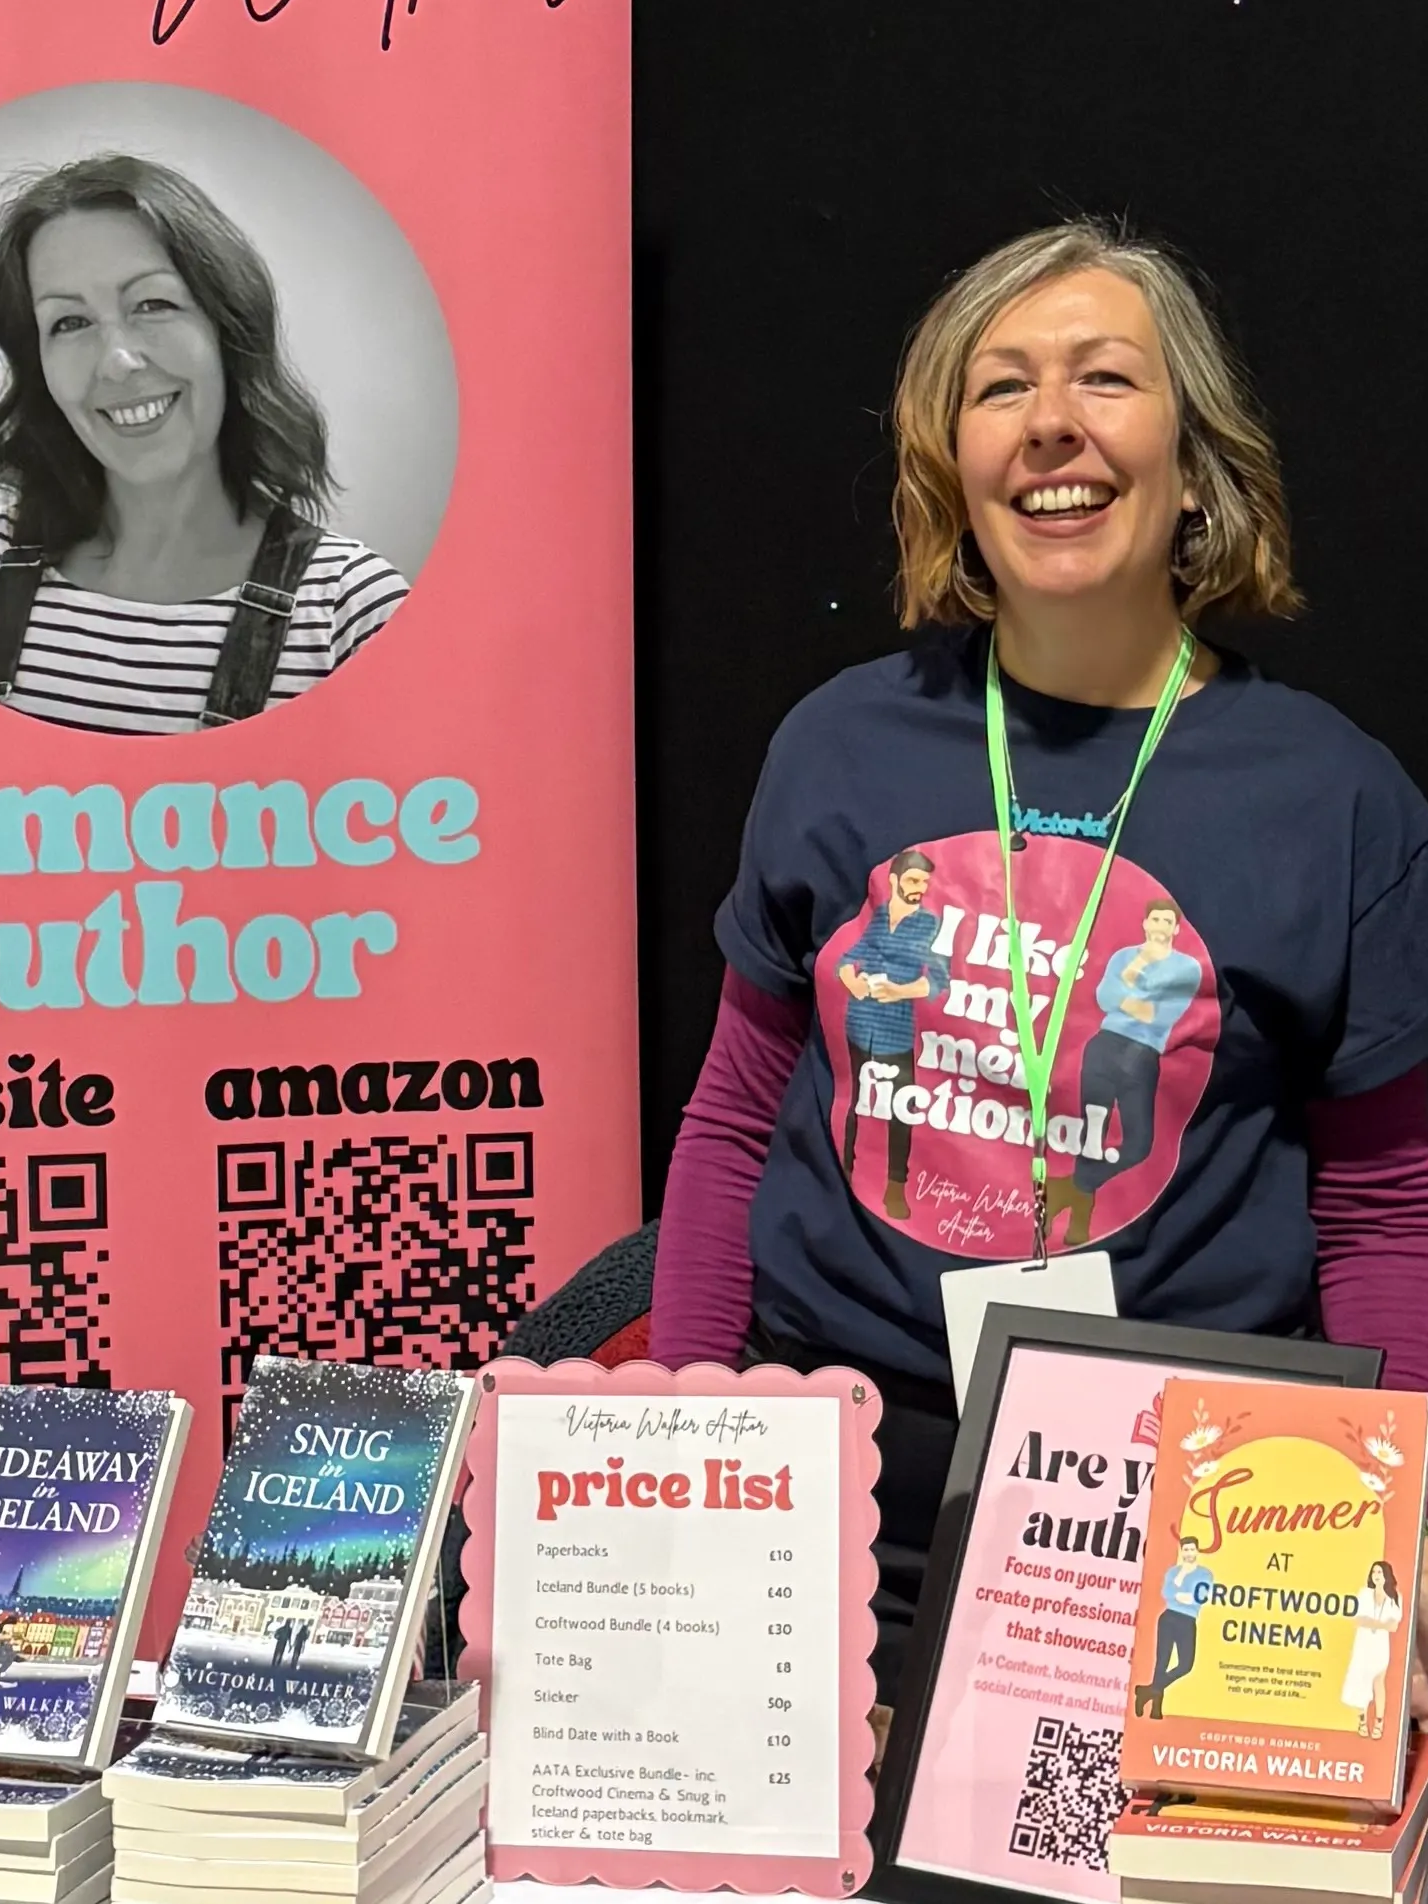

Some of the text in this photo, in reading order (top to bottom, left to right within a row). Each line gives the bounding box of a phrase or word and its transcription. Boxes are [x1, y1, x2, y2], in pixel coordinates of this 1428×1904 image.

[931, 905, 1089, 980] I like
[943, 980, 1050, 1045] my
[205, 1056, 543, 1123] amazon
[855, 1060, 1120, 1163] fictional.
[566, 1405, 768, 1443] Victoria Walker Author
[290, 1423, 392, 1464] SNUG
[319, 1461, 344, 1478] in
[1007, 1431, 1108, 1489] Are
[33, 1483, 58, 1498] in
[244, 1471, 405, 1516] ICELAND
[537, 1456, 794, 1520] price list
[1170, 1467, 1383, 1555] Summer
[537, 1544, 793, 1561] Paperbacks £10
[1266, 1552, 1293, 1572] AT
[1005, 1556, 1052, 1580] Focus
[1054, 1567, 1075, 1583] on
[1076, 1571, 1117, 1590] your
[537, 1581, 792, 1598] Iceland Bundle (5 books) £40
[975, 1587, 1031, 1608] create
[1193, 1581, 1360, 1619] CROFTWOOD
[535, 1617, 792, 1635] Croftwood Bundle (4 books) £30
[1006, 1621, 1127, 1658] that showcase
[1222, 1619, 1323, 1651] CINEMA
[535, 1653, 791, 1673] Tote Bag £8
[1054, 1666, 1122, 1690] bookmark
[183, 1668, 355, 1700] VICTORIA WALKER
[974, 1679, 1013, 1696] social
[1013, 1685, 1064, 1706] content
[1065, 1697, 1091, 1711] and
[3, 1696, 76, 1714] WALKER
[534, 1690, 792, 1712] Sticker 50p
[533, 1727, 563, 1740] Blind
[568, 1729, 597, 1741] Date
[602, 1729, 630, 1742] with
[647, 1731, 679, 1743] Book
[767, 1735, 791, 1746] £10
[532, 1764, 570, 1776] AATA
[576, 1765, 634, 1779] Exclusive
[769, 1773, 791, 1784] £25
[1152, 1745, 1365, 1784] VICTORIA WALKER
[532, 1785, 726, 1805] Croftwood Cinema & Snug in
[532, 1806, 578, 1819] Iceland
[532, 1827, 652, 1845] sticker & tote bag
